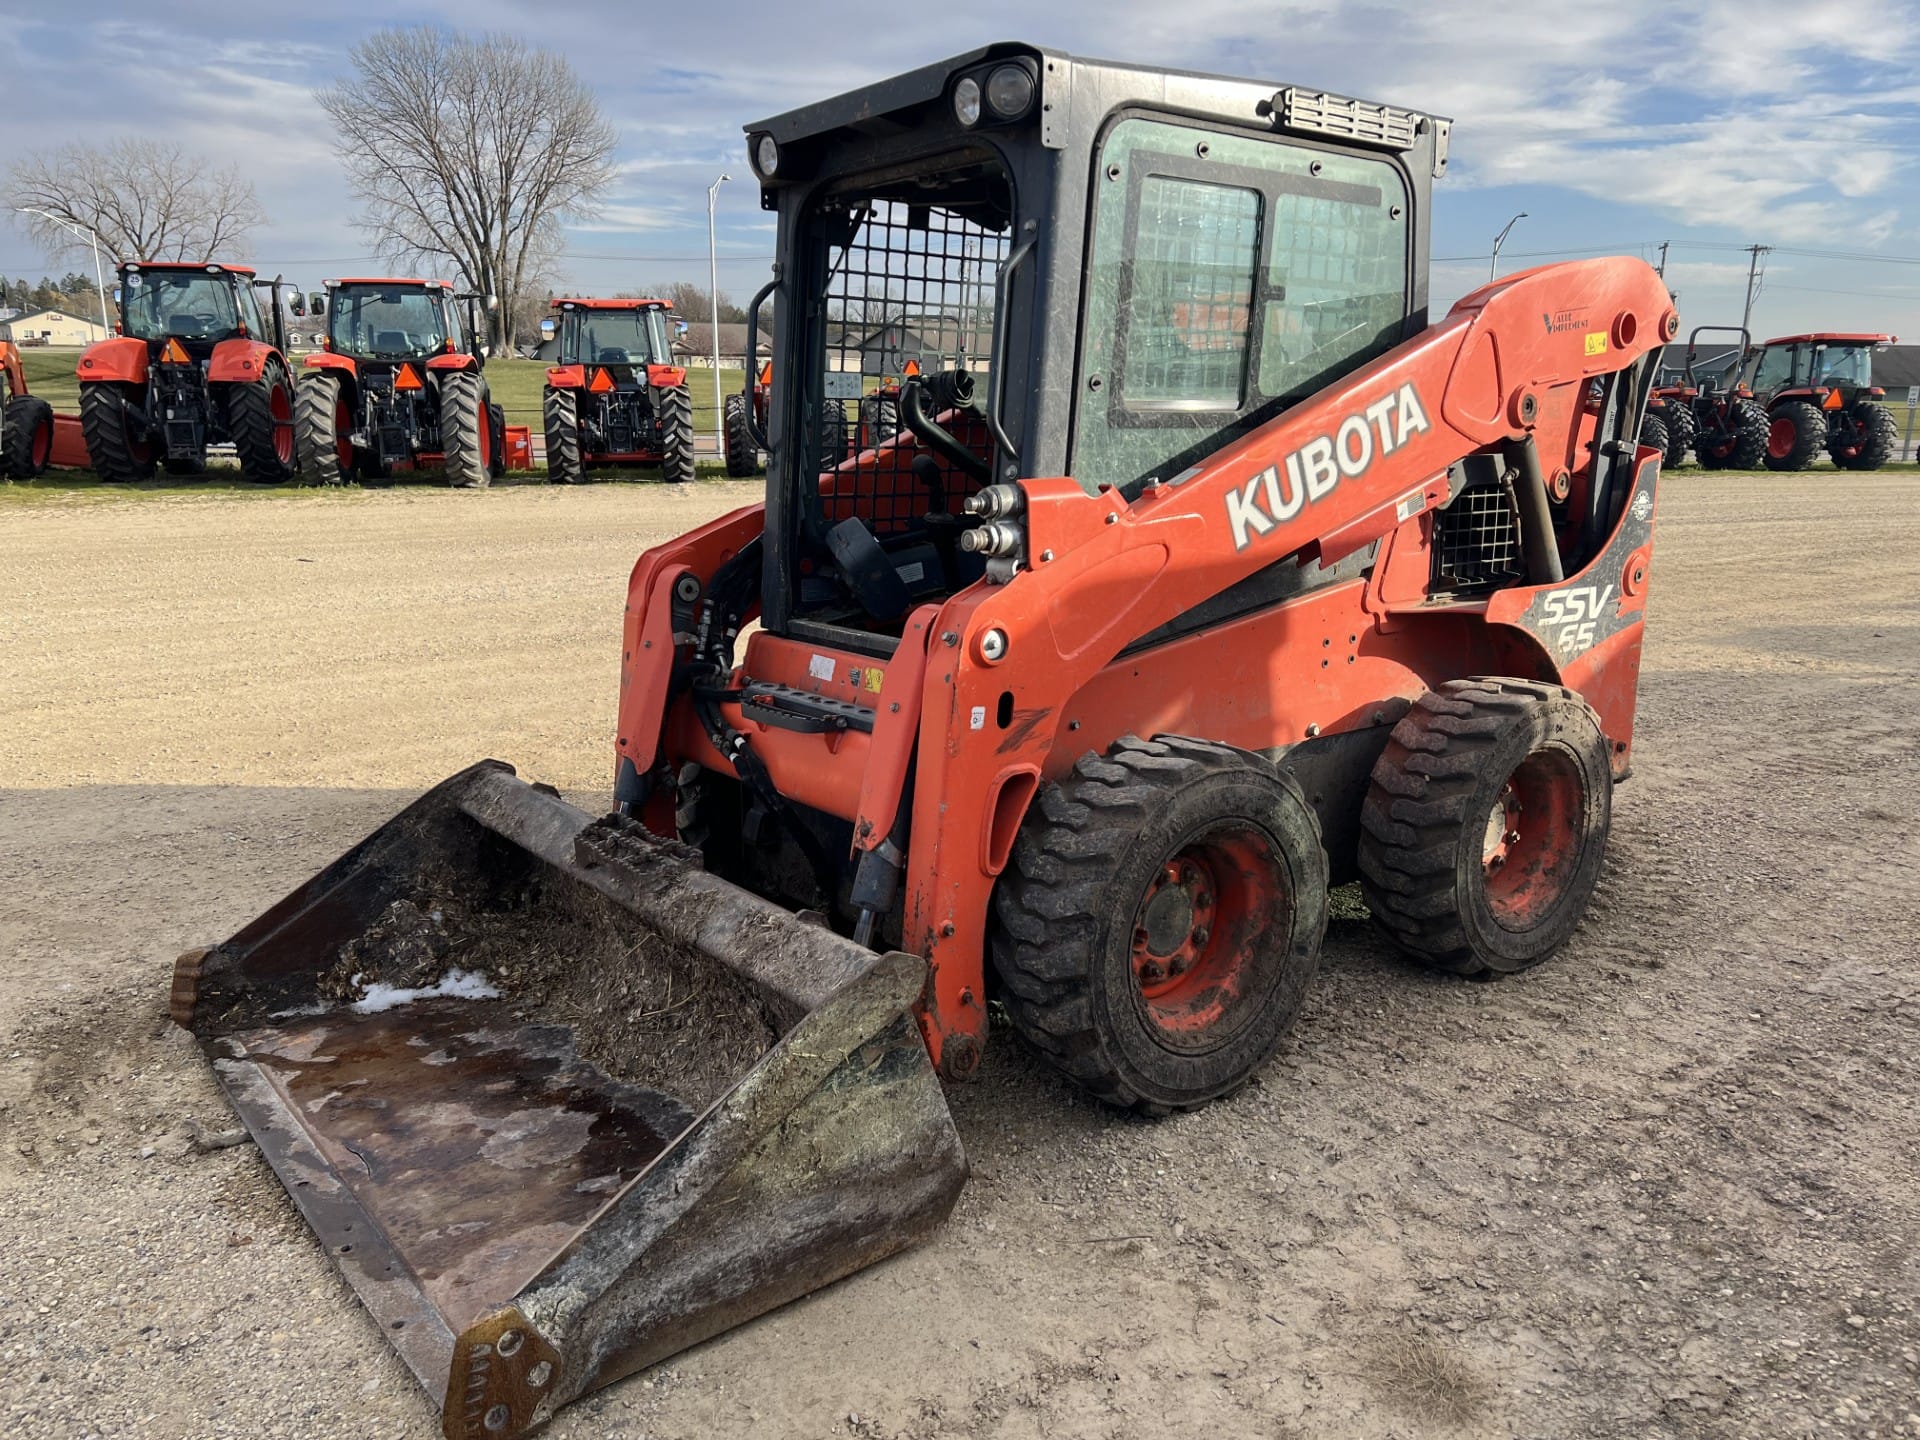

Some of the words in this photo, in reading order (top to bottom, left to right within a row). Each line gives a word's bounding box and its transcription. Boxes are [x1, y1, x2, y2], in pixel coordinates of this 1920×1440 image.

[1553, 319, 1589, 333] IMPLEMENT
[1225, 383, 1429, 551] KUBOTA
[1538, 584, 1614, 626] SSV
[1558, 622, 1597, 653] 65
